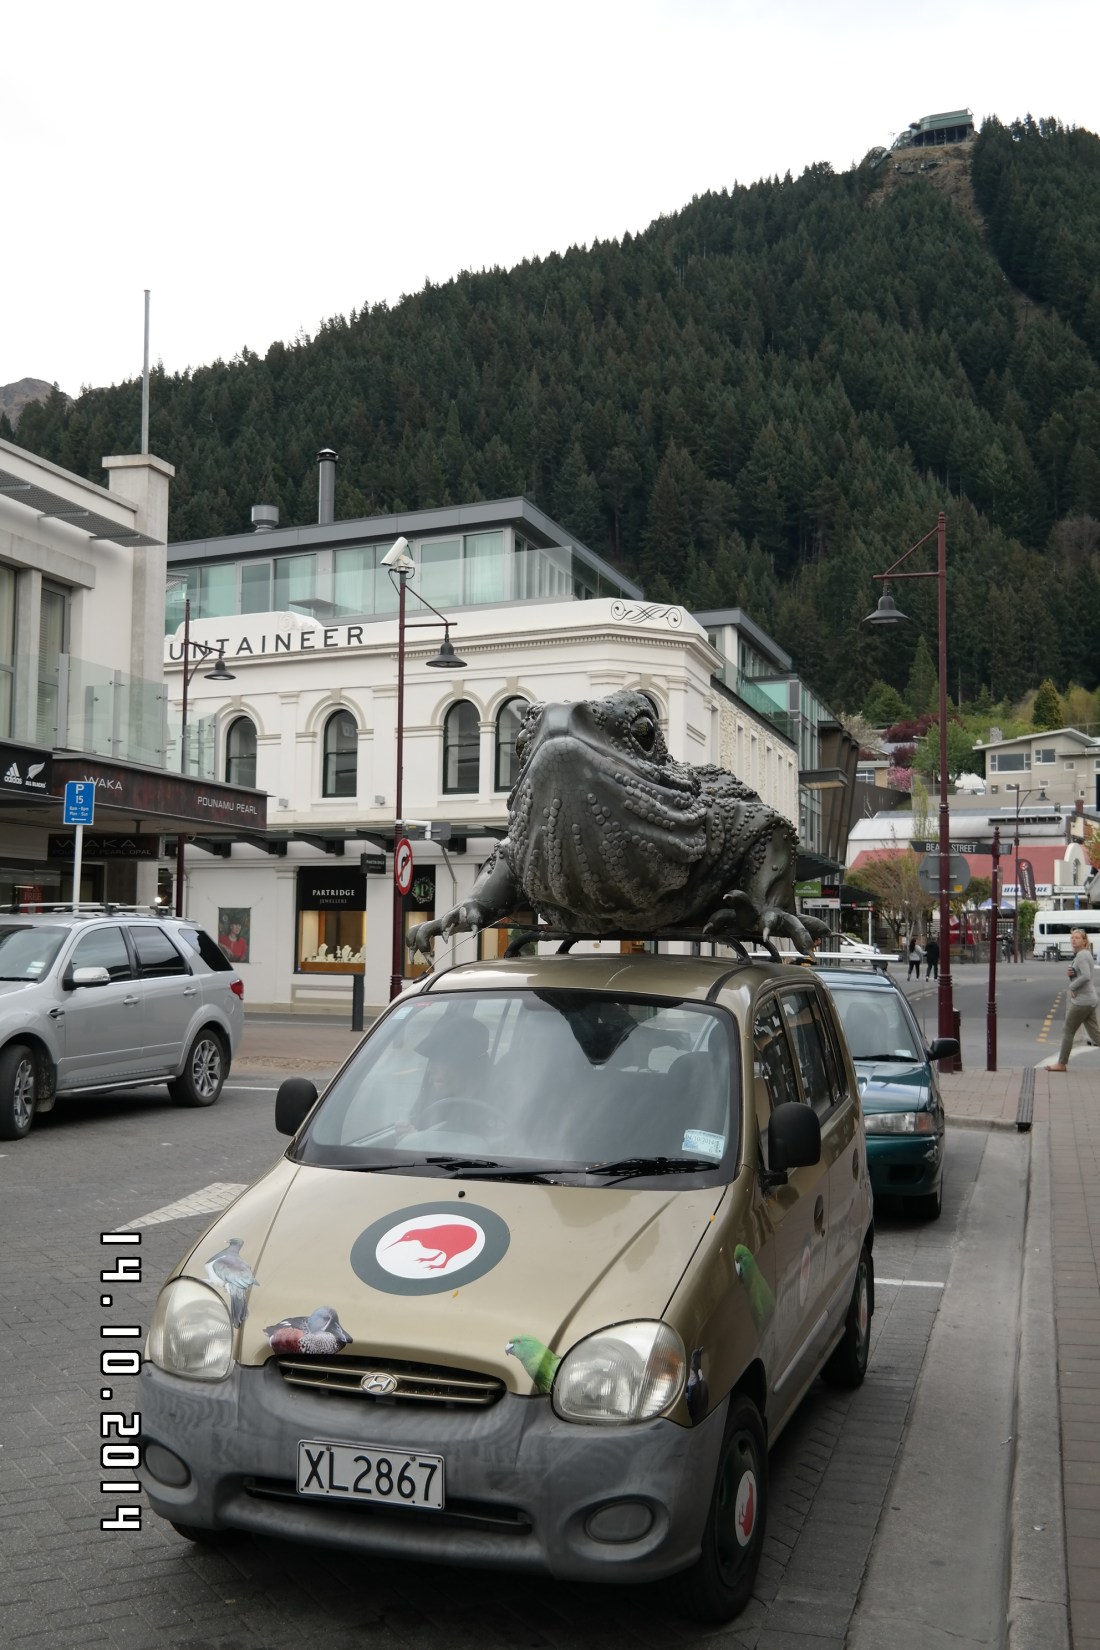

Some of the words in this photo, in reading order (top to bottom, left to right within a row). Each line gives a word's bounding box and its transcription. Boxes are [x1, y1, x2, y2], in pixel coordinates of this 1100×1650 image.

[4, 775, 22, 785] adidas
[84, 775, 123, 791] WAKA
[75, 784, 85, 794] P
[75, 795, 84, 804] 15
[197, 796, 234, 811] POUNAMU
[236, 803, 258, 815] PEARL
[55, 839, 137, 848] WAKA
[951, 843, 977, 853] STREET
[304, 1448, 438, 1502] XL2867
